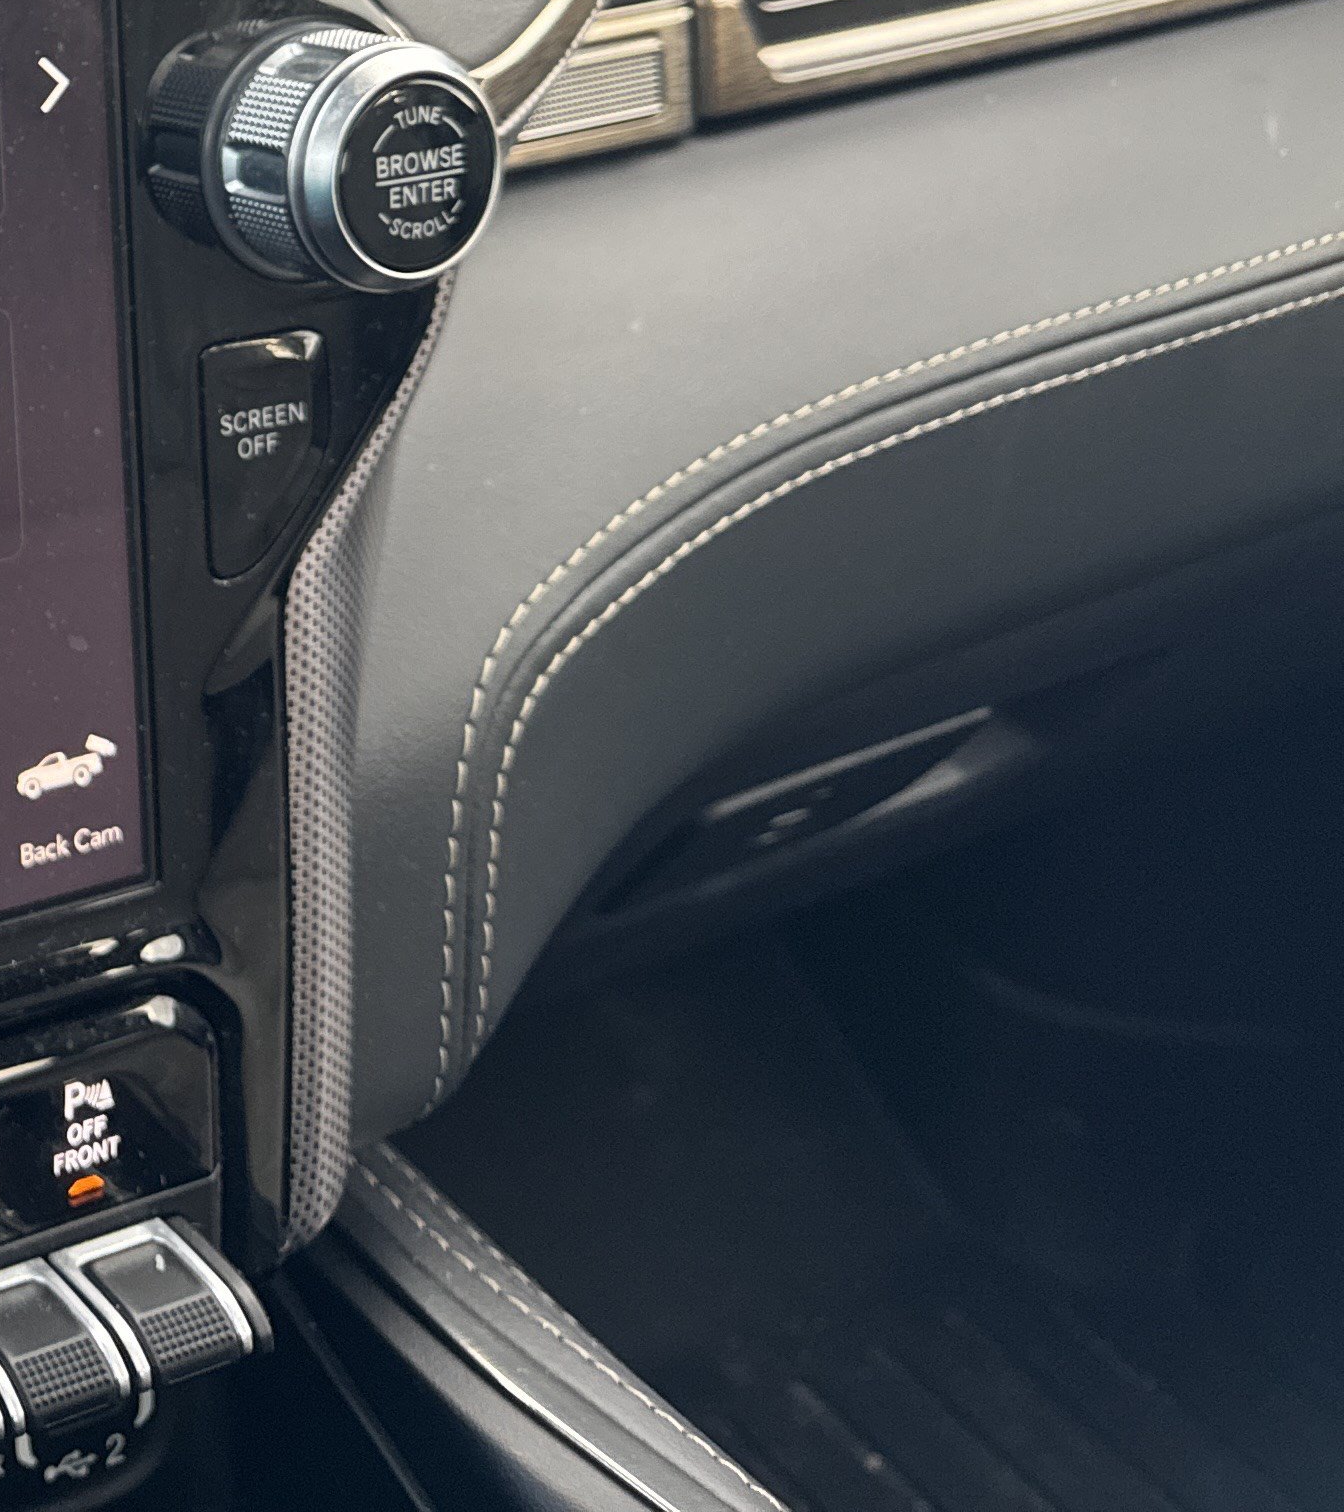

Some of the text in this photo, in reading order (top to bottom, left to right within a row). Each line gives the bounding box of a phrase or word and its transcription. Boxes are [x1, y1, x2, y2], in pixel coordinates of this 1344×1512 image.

[394, 103, 443, 127] TUNE
[375, 144, 466, 179] BROWSE
[389, 178, 457, 210] ENTER
[389, 212, 455, 240] SCROLL
[220, 401, 307, 437] SCREEN
[237, 432, 279, 461] OFF
[19, 822, 124, 869] Back Cam
[66, 1115, 108, 1145] OFF
[54, 1134, 120, 1177] FRONT
